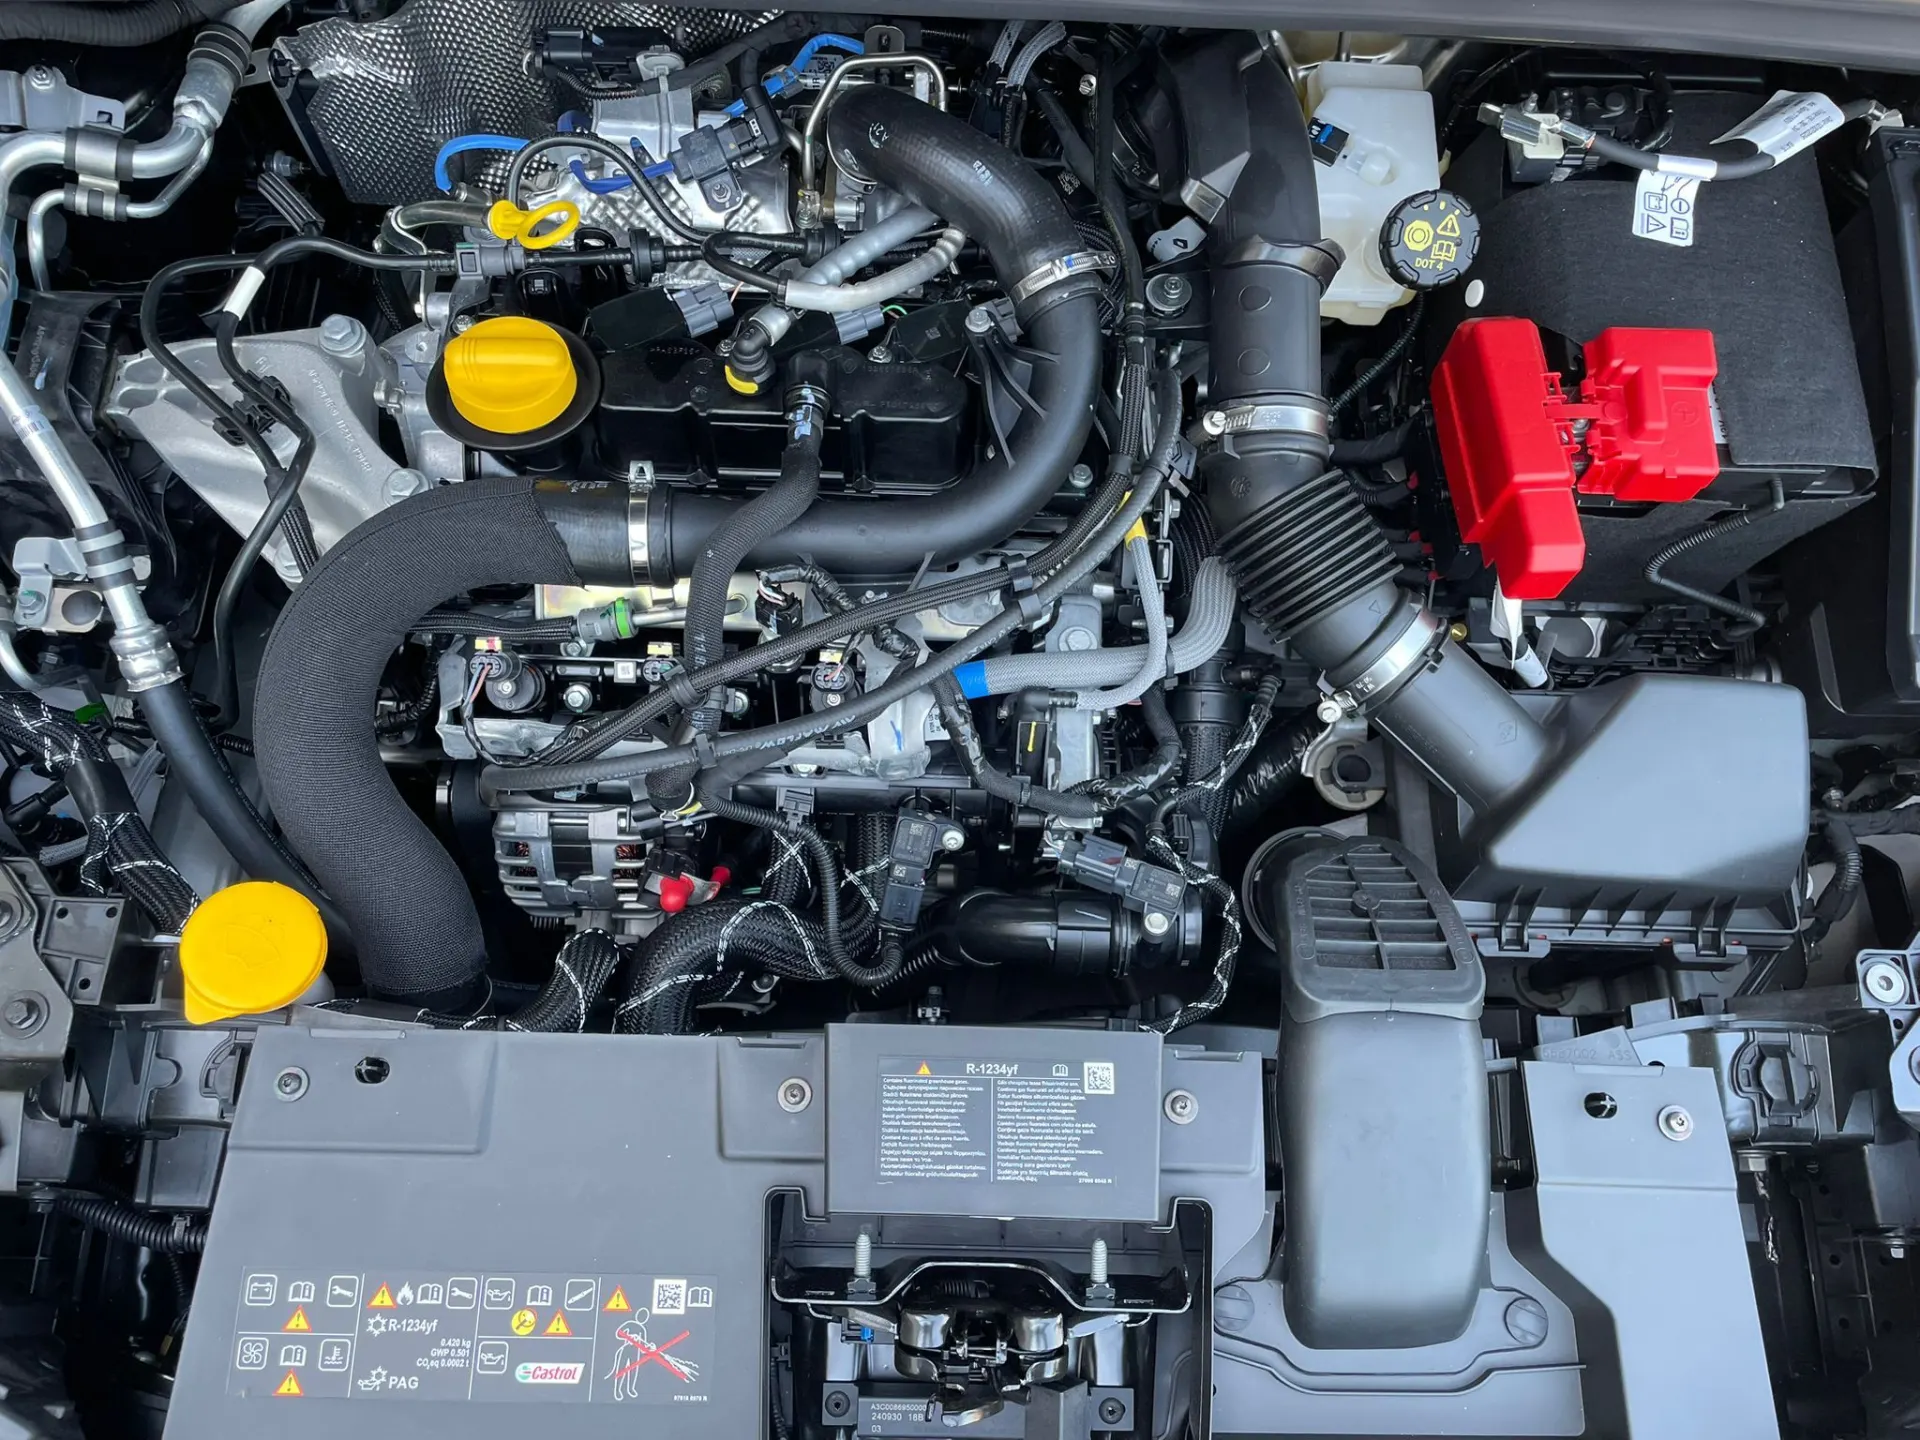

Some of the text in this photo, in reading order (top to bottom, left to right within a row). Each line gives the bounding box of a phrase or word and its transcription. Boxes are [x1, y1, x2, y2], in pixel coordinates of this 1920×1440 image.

[1415, 257, 1444, 271] DOT 4
[966, 1063, 1019, 1077] R-1234yf
[388, 1319, 438, 1335] R-1234yf
[440, 1338, 471, 1348] 0.420 kg
[430, 1348, 470, 1357] GWP 0.501
[440, 1358, 465, 1367] 0.0002
[531, 1365, 578, 1380] Castrol
[388, 1376, 419, 1389] PAG
[871, 1412, 902, 1420] 240930
[871, 1425, 881, 1433] 03
